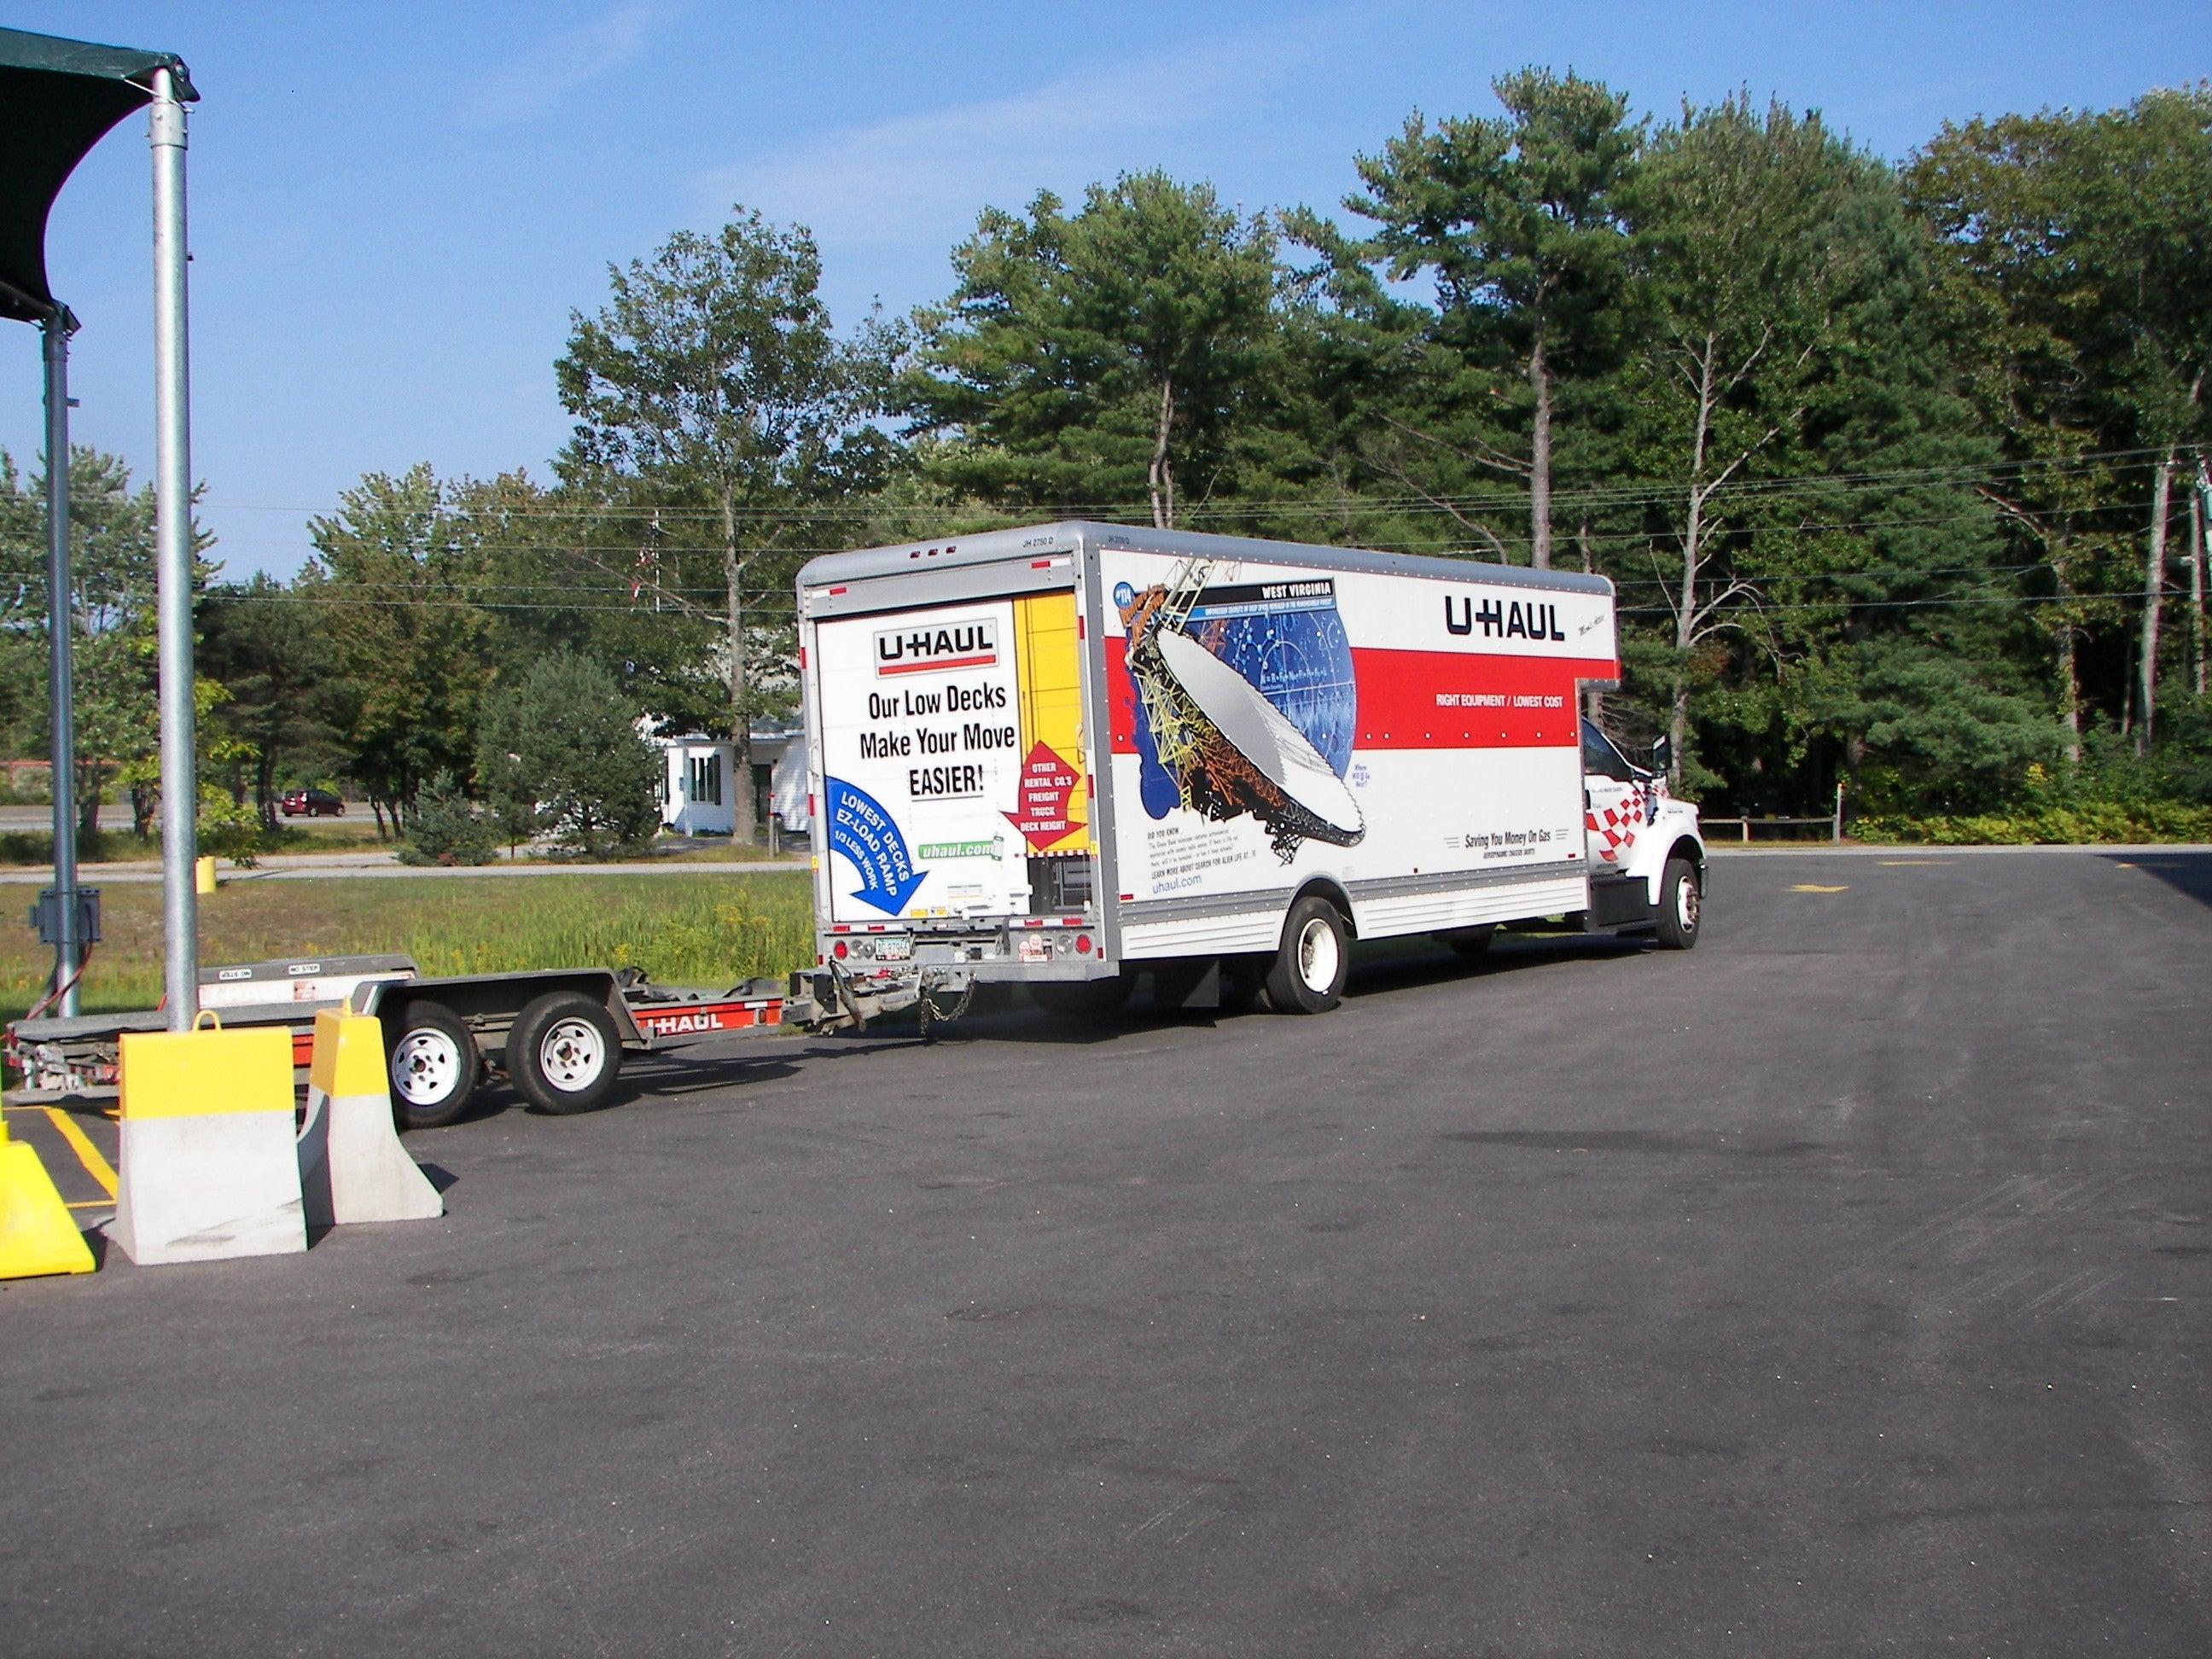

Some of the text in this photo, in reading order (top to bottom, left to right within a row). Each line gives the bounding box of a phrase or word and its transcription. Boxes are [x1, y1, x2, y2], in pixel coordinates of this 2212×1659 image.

[1262, 581, 1331, 599] WEST VIRGINIA
[1445, 596, 1565, 642] U-HAUL
[879, 626, 993, 660] U-HAUL
[869, 682, 1006, 719] Our Low Decks
[1435, 694, 1460, 707] RIGHT
[1461, 694, 1505, 707] EQUIPMENT
[1513, 695, 1542, 707] LOWEST
[1544, 695, 1563, 707] COST
[860, 723, 1015, 759] Make Your Move
[1032, 761, 1057, 773] OTHER
[910, 765, 984, 796] EASIER!
[1024, 777, 1052, 788] RENTAL
[1028, 791, 1059, 802] FREIGHT
[1030, 806, 1056, 817] TRUCK
[1020, 820, 1066, 832] DECK HEIGHT
[841, 791, 910, 882] LOWEST DECKS
[1465, 828, 1551, 849] Saving You Money On Gas
[836, 807, 898, 896] EZ-LOAD RAMP
[923, 843, 996, 859] uhaul.com
[846, 836, 865, 860] LESS
[862, 857, 878, 890] WORK
[1179, 863, 1193, 873] ABOUT
[1152, 875, 1202, 894] uhaul.com
